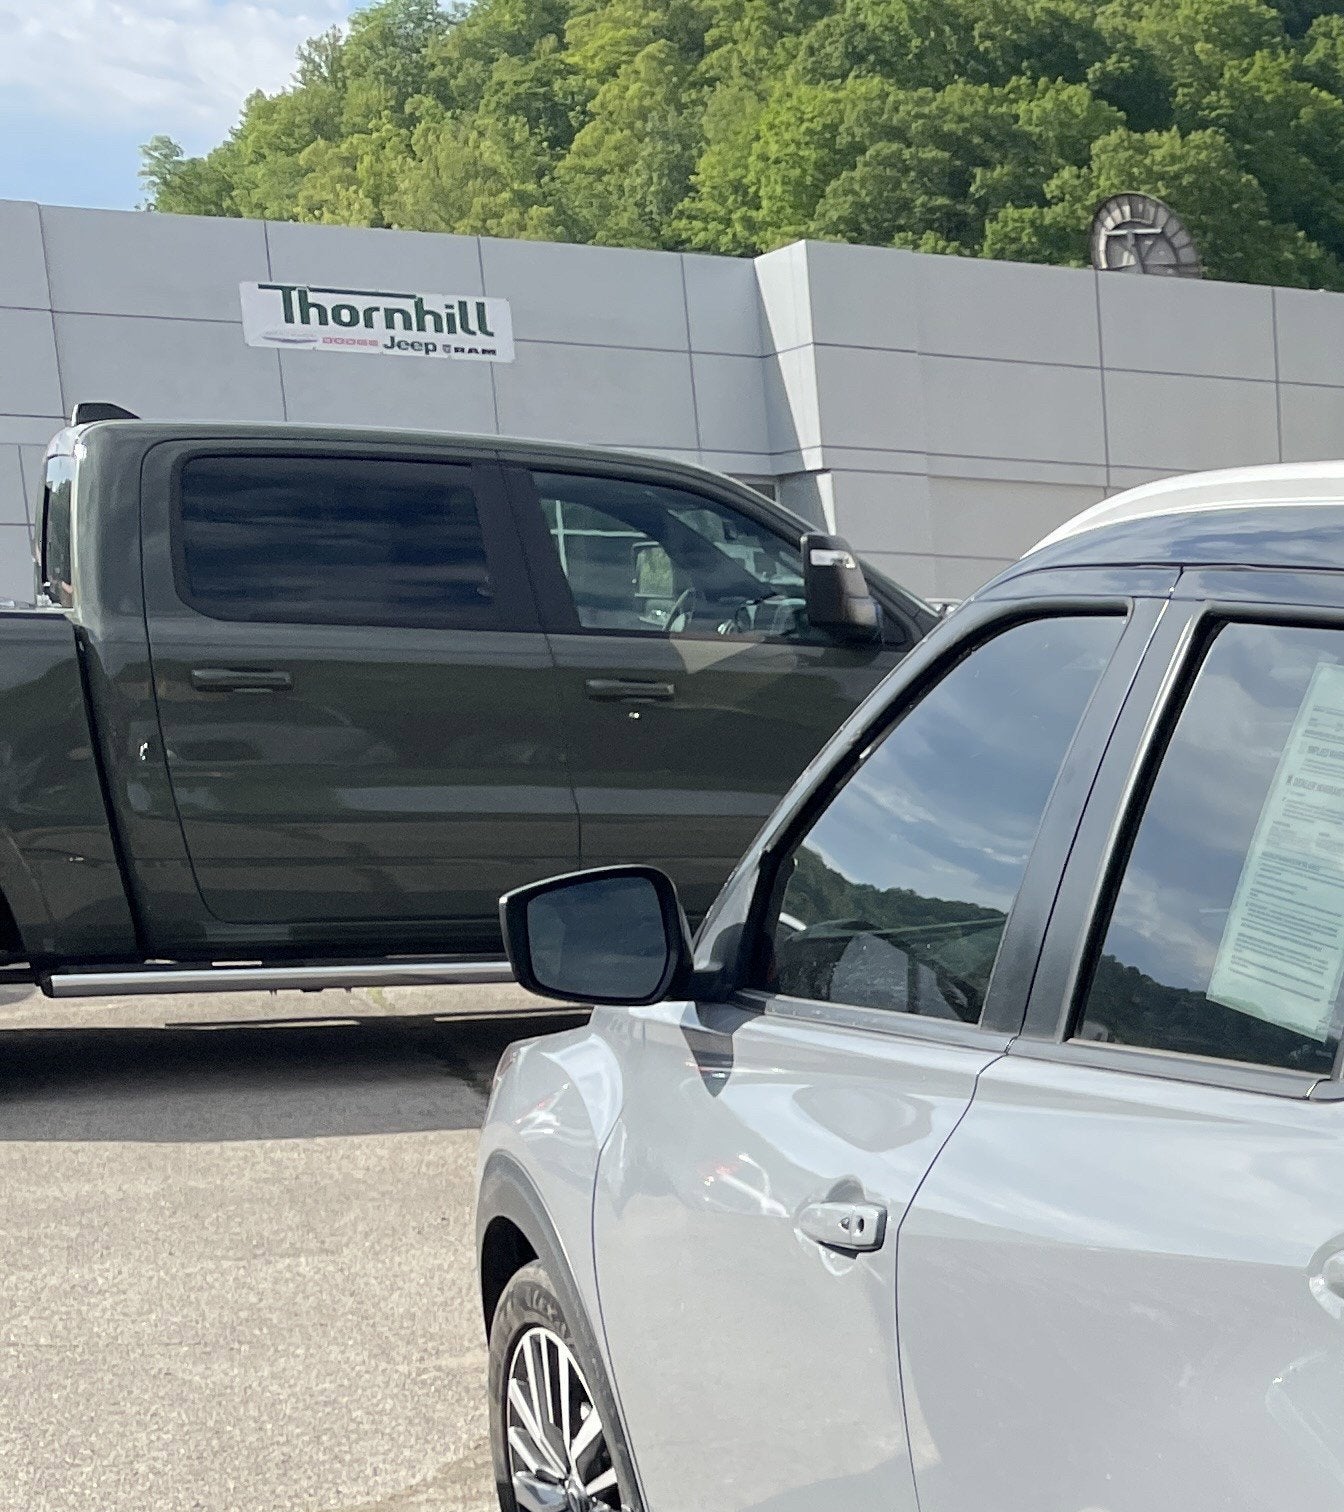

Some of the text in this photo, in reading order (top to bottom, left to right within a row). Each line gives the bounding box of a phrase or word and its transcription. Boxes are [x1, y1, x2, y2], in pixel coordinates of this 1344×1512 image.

[257, 283, 494, 337] Thornhill
[384, 335, 437, 356] Jeep
[454, 347, 497, 356] RAM
